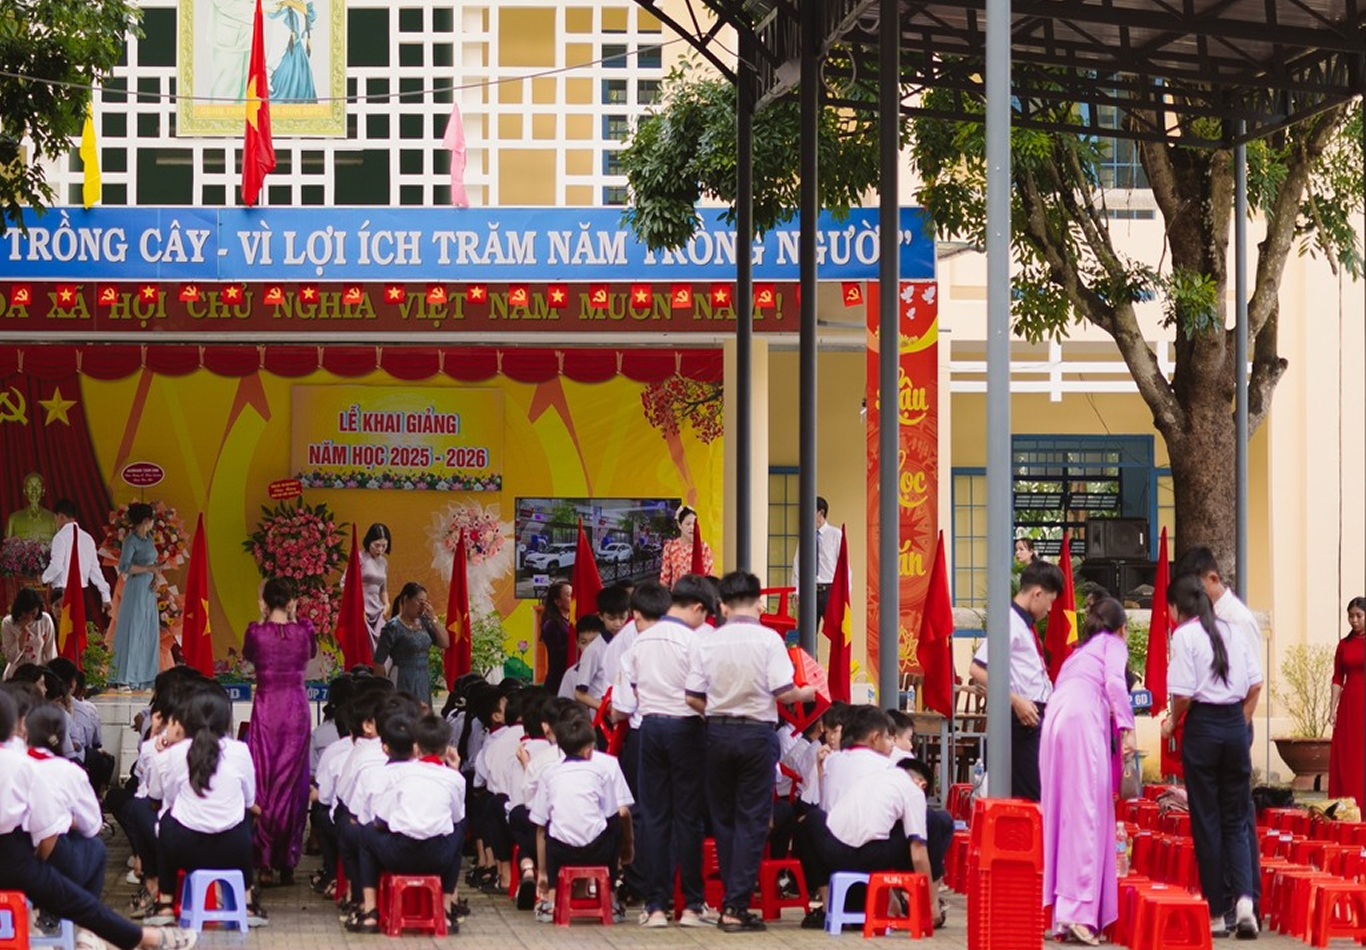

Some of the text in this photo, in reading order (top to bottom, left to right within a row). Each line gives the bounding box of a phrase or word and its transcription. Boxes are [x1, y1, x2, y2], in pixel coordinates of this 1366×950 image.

[3, 209, 128, 262] TRỒNG
[139, 219, 210, 263] CÂY
[237, 220, 273, 265] VÌ
[284, 225, 346, 276] LỢI
[357, 220, 422, 265] ÍCH
[432, 221, 537, 265] TRĂM
[547, 222, 628, 265] NĂM
[338, 404, 457, 434] LỄ KHAI GIẢNG
[308, 441, 347, 465] NĂM
[352, 447, 385, 470] HỌC
[390, 447, 430, 467] 2025
[446, 448, 486, 468] 2026
